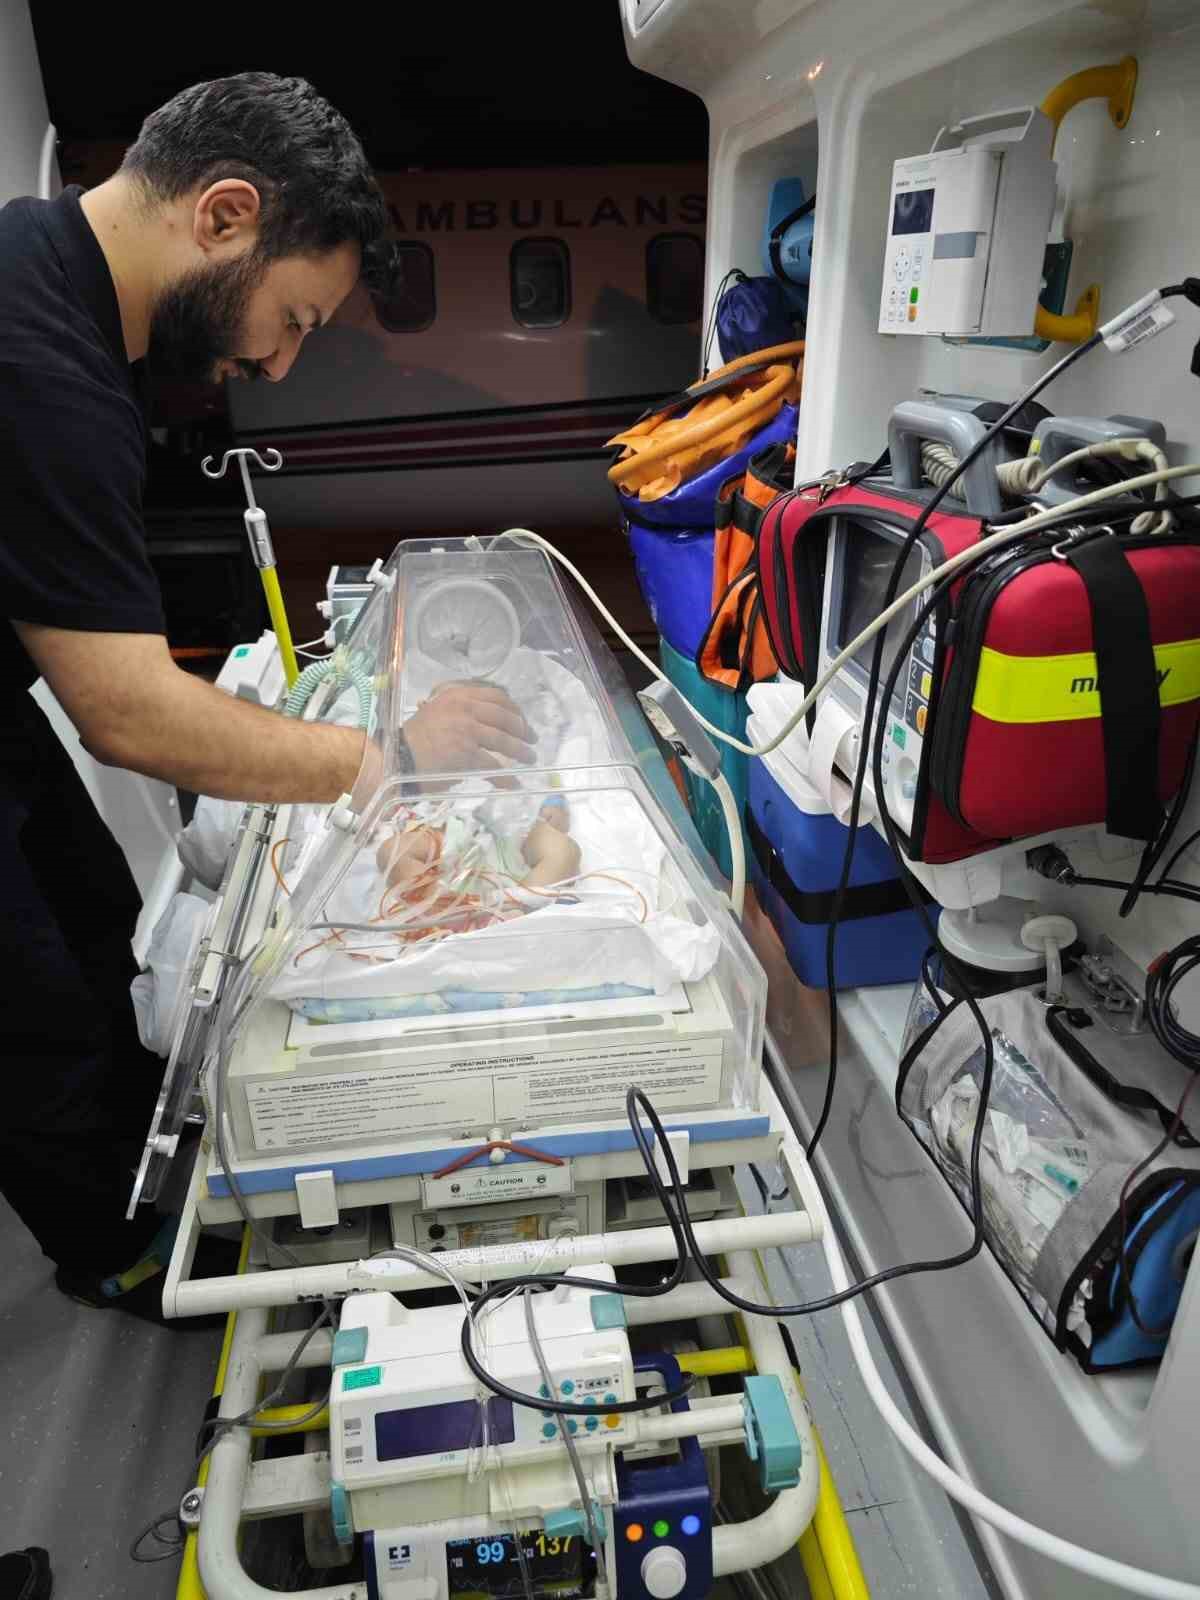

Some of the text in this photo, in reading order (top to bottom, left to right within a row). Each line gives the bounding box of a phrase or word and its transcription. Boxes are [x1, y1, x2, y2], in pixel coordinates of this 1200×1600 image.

[489, 1176, 523, 1187] CAUTION
[476, 1541, 505, 1565] 99
[535, 1534, 574, 1557] 137
